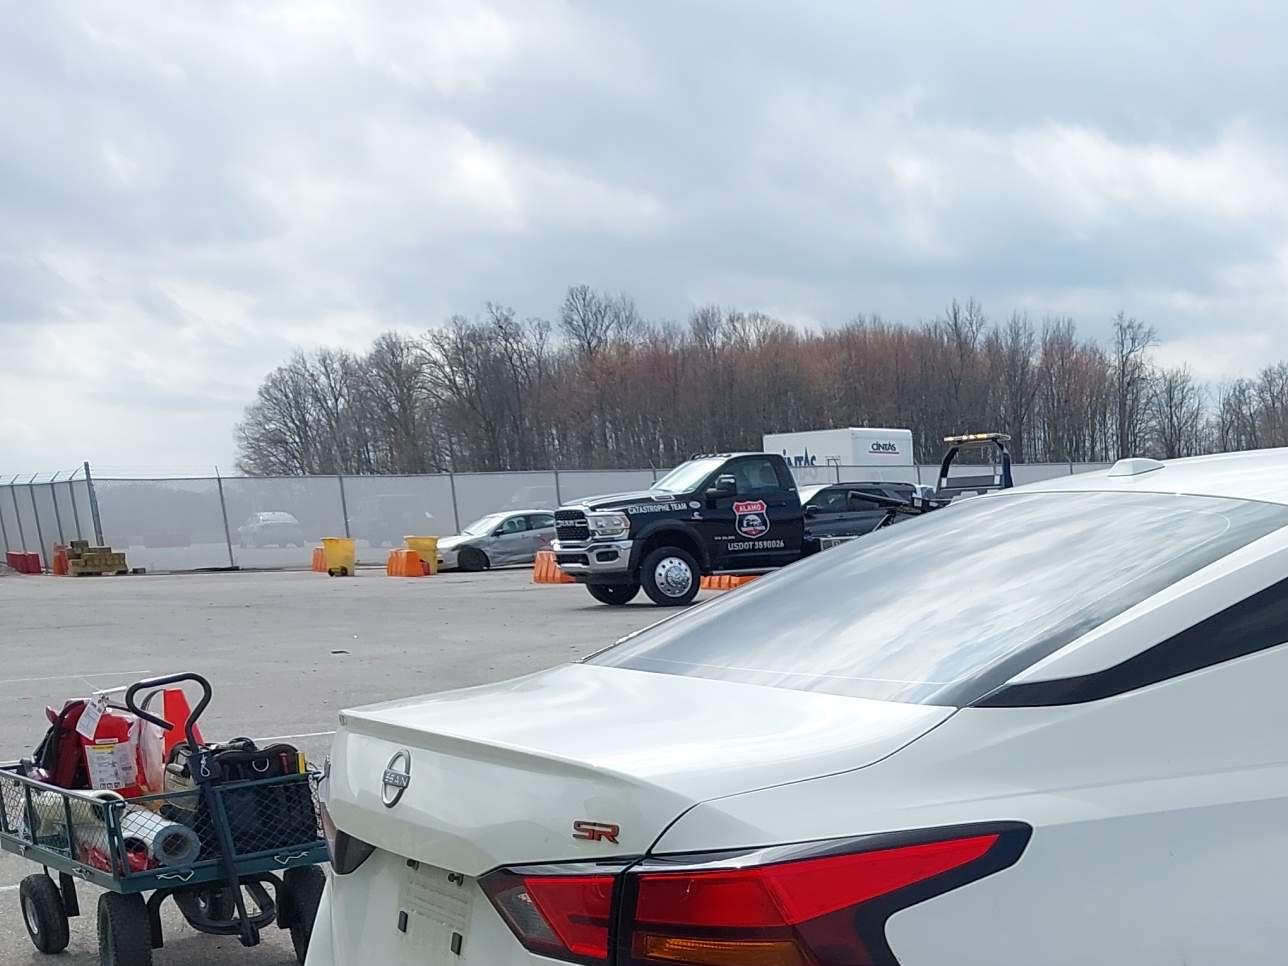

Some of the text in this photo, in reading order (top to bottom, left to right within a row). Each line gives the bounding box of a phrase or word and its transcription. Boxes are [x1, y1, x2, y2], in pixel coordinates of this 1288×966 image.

[628, 503, 670, 514] CATASTROPHE
[671, 502, 688, 511] TEAM
[739, 503, 761, 512] ALAMO
[728, 542, 754, 551] USDOT
[573, 820, 620, 844] SR
